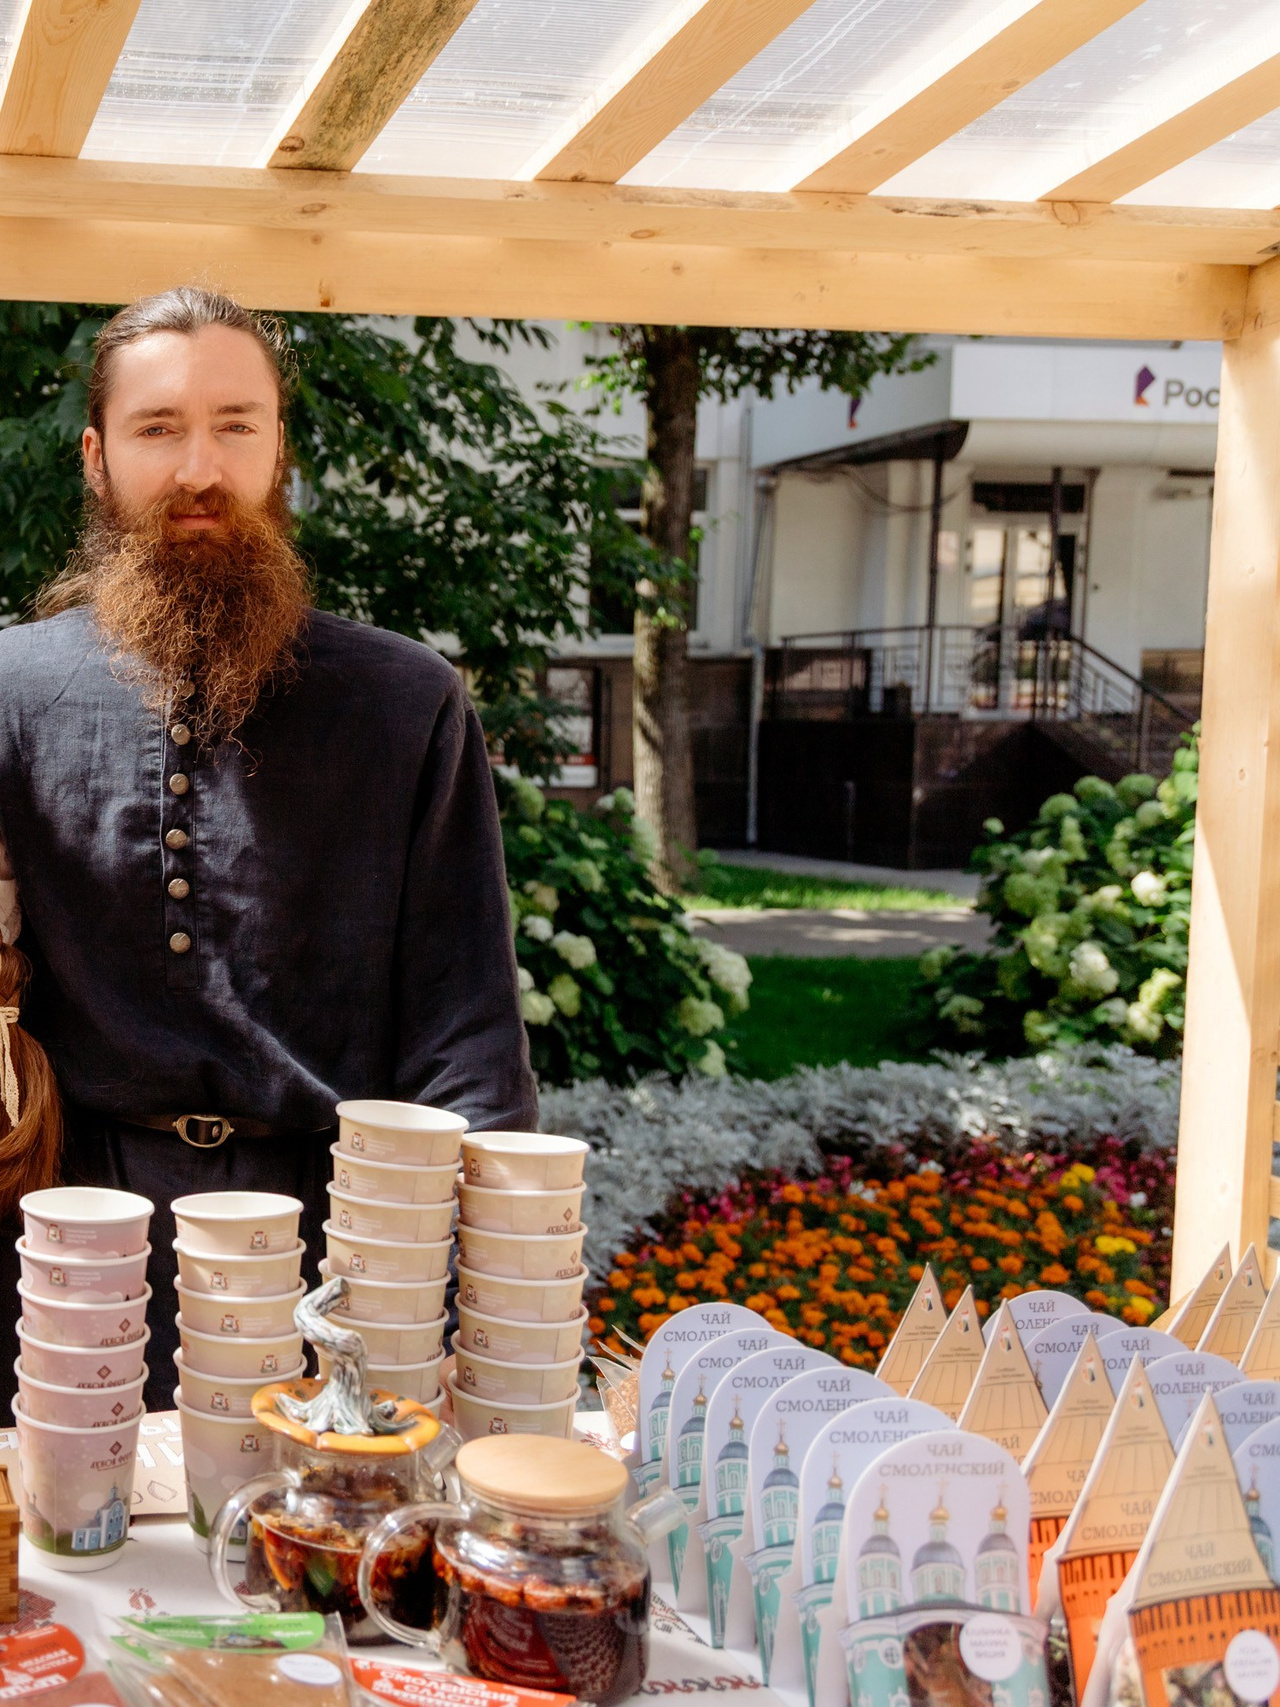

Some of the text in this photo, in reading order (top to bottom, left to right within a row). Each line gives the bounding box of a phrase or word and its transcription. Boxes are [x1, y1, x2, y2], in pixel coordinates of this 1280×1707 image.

[1028, 1300, 1055, 1313] ЧАЙ
[700, 1311, 731, 1325] ЧАЙ
[663, 1330, 733, 1342] СМОЛЕН
[1071, 1322, 1100, 1336] ЧАЙ
[738, 1338, 769, 1351] ЧАЙ
[1121, 1336, 1151, 1351] ЧАЙ
[773, 1356, 806, 1370] ЧАЙ
[1174, 1360, 1206, 1377] ЧАЙ
[731, 1376, 794, 1389] СМОЛЕ
[817, 1378, 851, 1393] ЧАЙ
[775, 1398, 869, 1413] СМОЛЕНС
[1242, 1390, 1276, 1406] ЧАЙ
[874, 1408, 909, 1424] ЧАЙ
[829, 1430, 921, 1445] СМОЛЕНС
[927, 1442, 964, 1457] ЧАЙ
[878, 1461, 1006, 1478] СМОЛЕНСКИЙ
[1066, 1469, 1089, 1482] ЧА
[1120, 1499, 1153, 1516] ЧАЙ
[1184, 1541, 1215, 1560] ЧАЙ
[1147, 1558, 1254, 1588] СМОЛЕНСКИЙ
[379, 1670, 519, 1703] СМОЛЕНСКИЕ
[402, 1683, 489, 1707] СЛАСТИ
